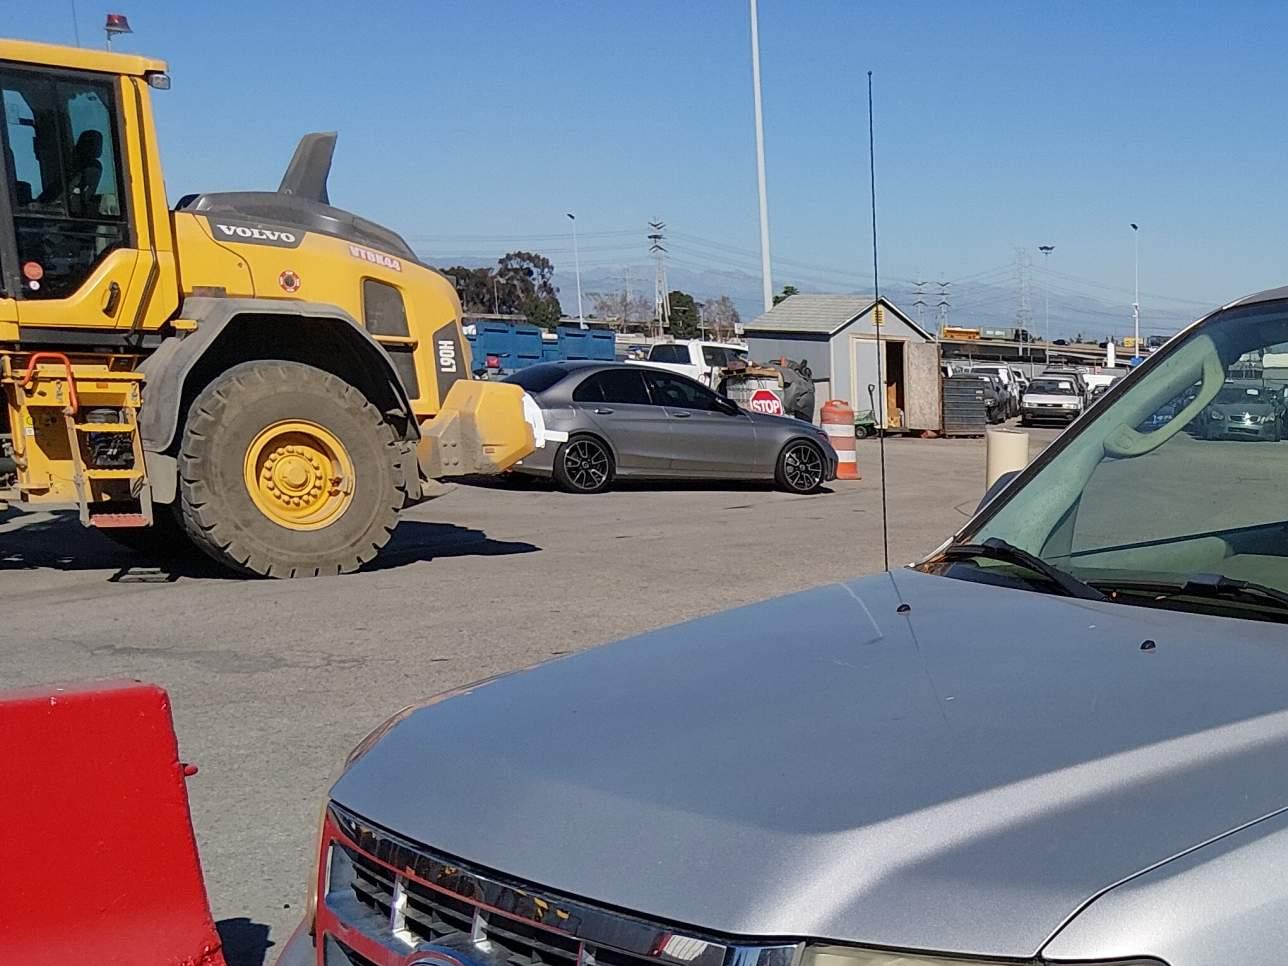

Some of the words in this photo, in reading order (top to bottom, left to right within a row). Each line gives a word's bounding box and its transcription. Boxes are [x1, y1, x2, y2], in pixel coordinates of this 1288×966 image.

[216, 224, 296, 242] VOLVO
[438, 340, 457, 373] L90H
[752, 400, 780, 414] STOP
